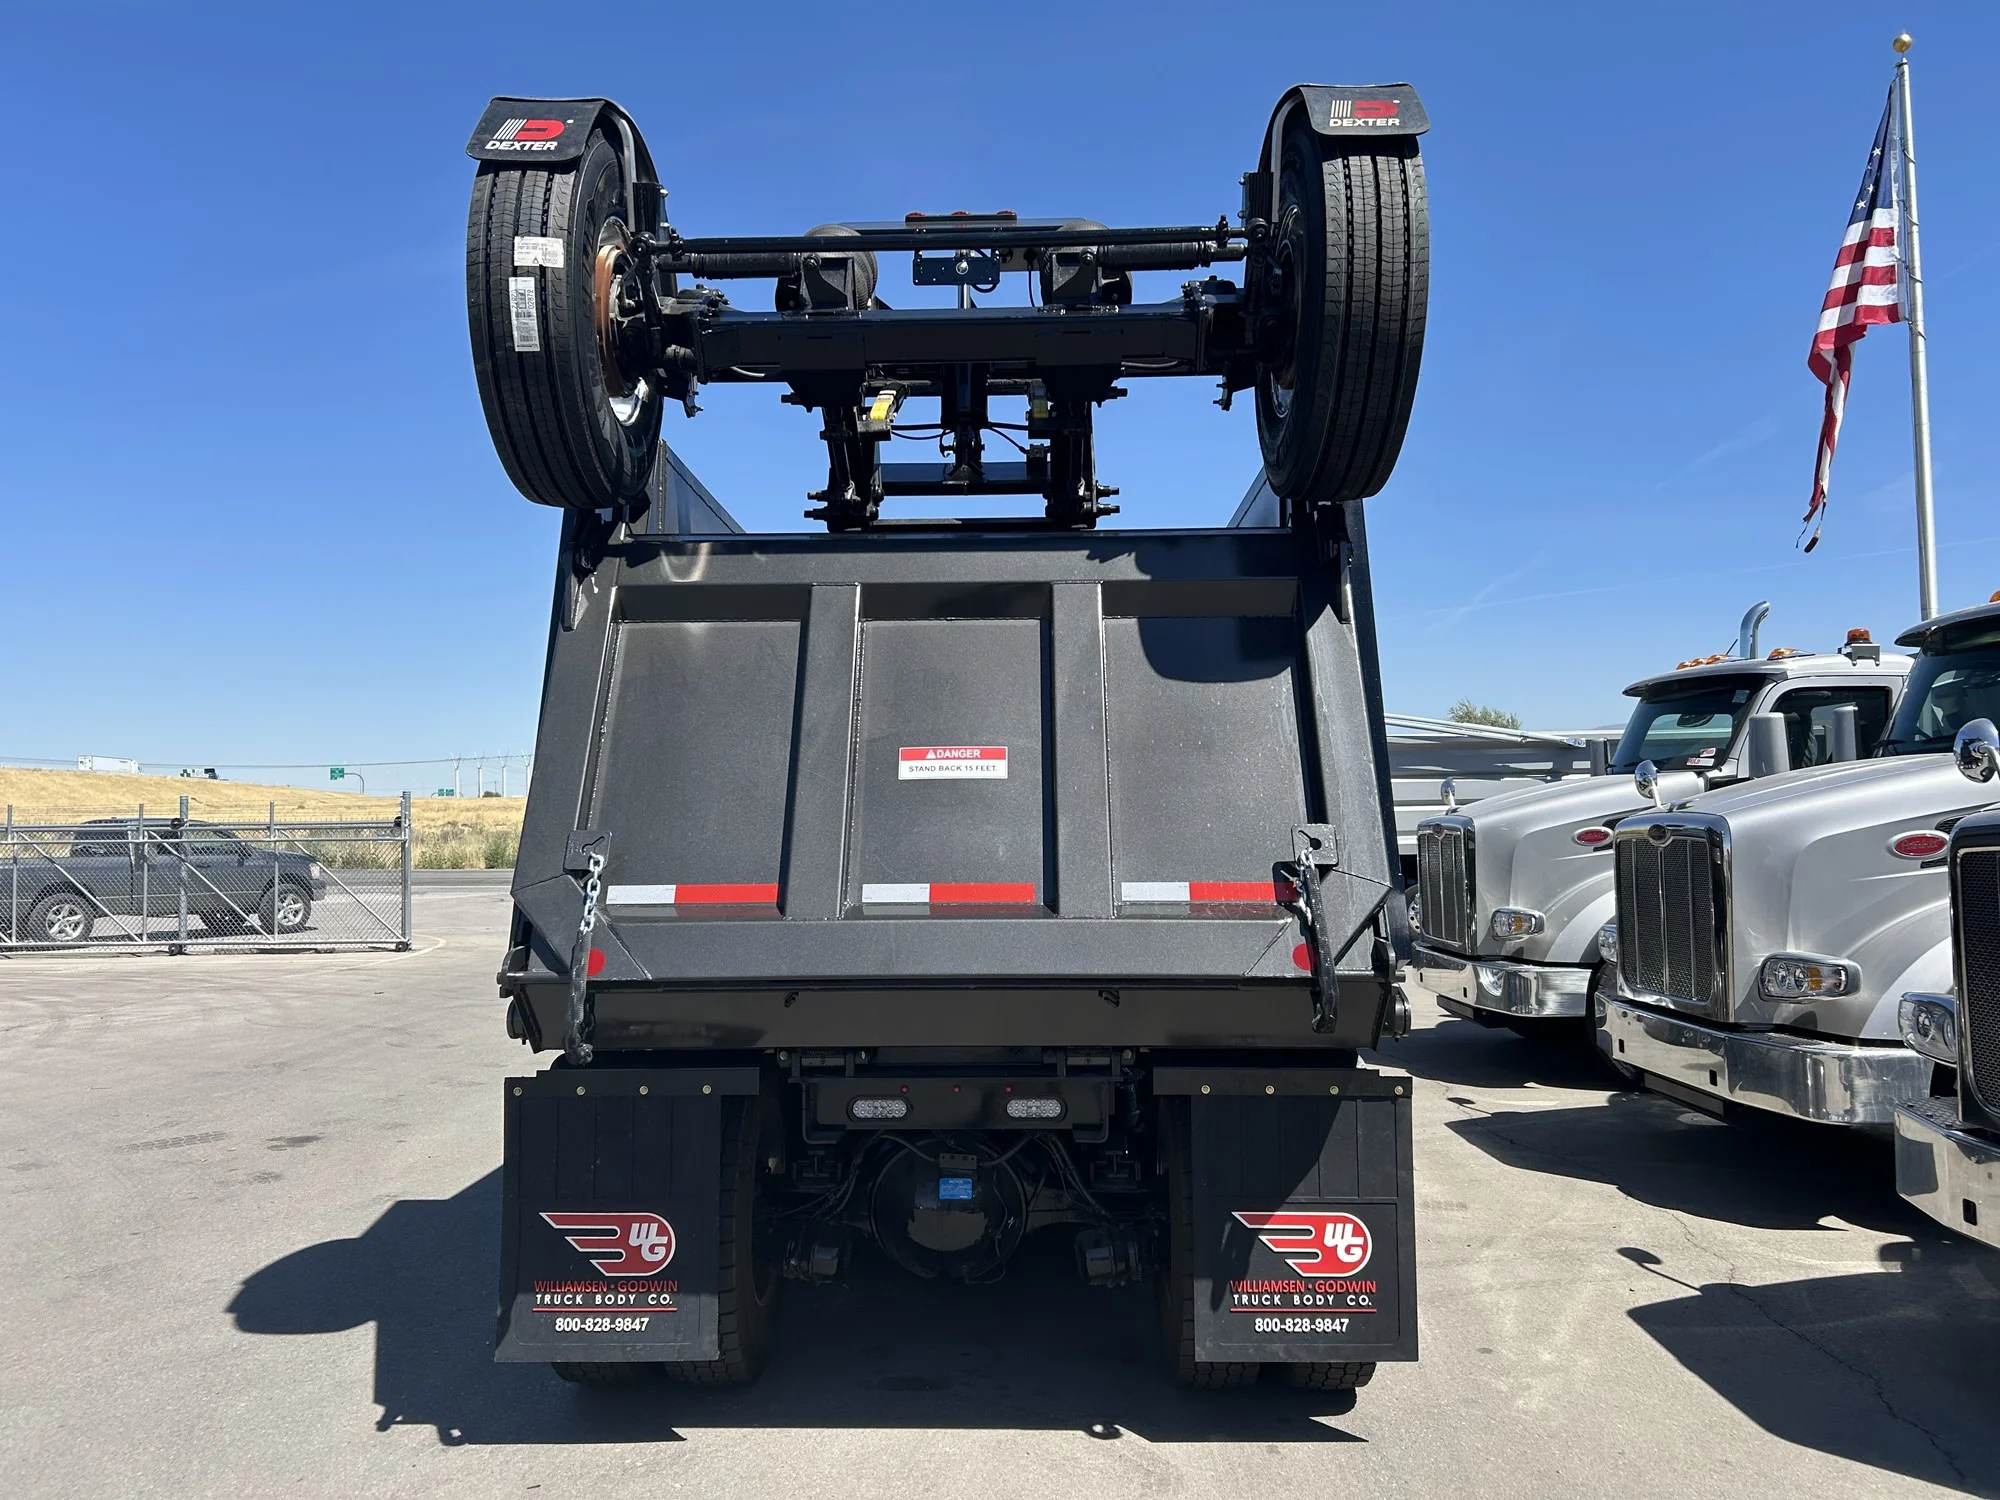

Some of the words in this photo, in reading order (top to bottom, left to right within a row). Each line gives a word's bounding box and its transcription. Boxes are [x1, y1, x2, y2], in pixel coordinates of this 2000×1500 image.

[1329, 118, 1400, 127] DEXTER
[484, 140, 558, 151] DEXTER
[936, 749, 981, 759] DANGER
[534, 1280, 608, 1292] WILLIAMSEN
[617, 1280, 678, 1292] GODWIN
[1230, 1280, 1305, 1293] WILLIAMSEN
[1315, 1280, 1376, 1293] GODWIN
[535, 1294, 583, 1304] TRUCK
[595, 1294, 636, 1304] BODY
[647, 1294, 673, 1304] CO.
[1233, 1294, 1281, 1305] TRUCK
[1293, 1294, 1335, 1305] BODY
[1347, 1294, 1372, 1305] CO.
[555, 1317, 650, 1332] 800-828-9847
[1254, 1318, 1349, 1332] 800-828-9847
